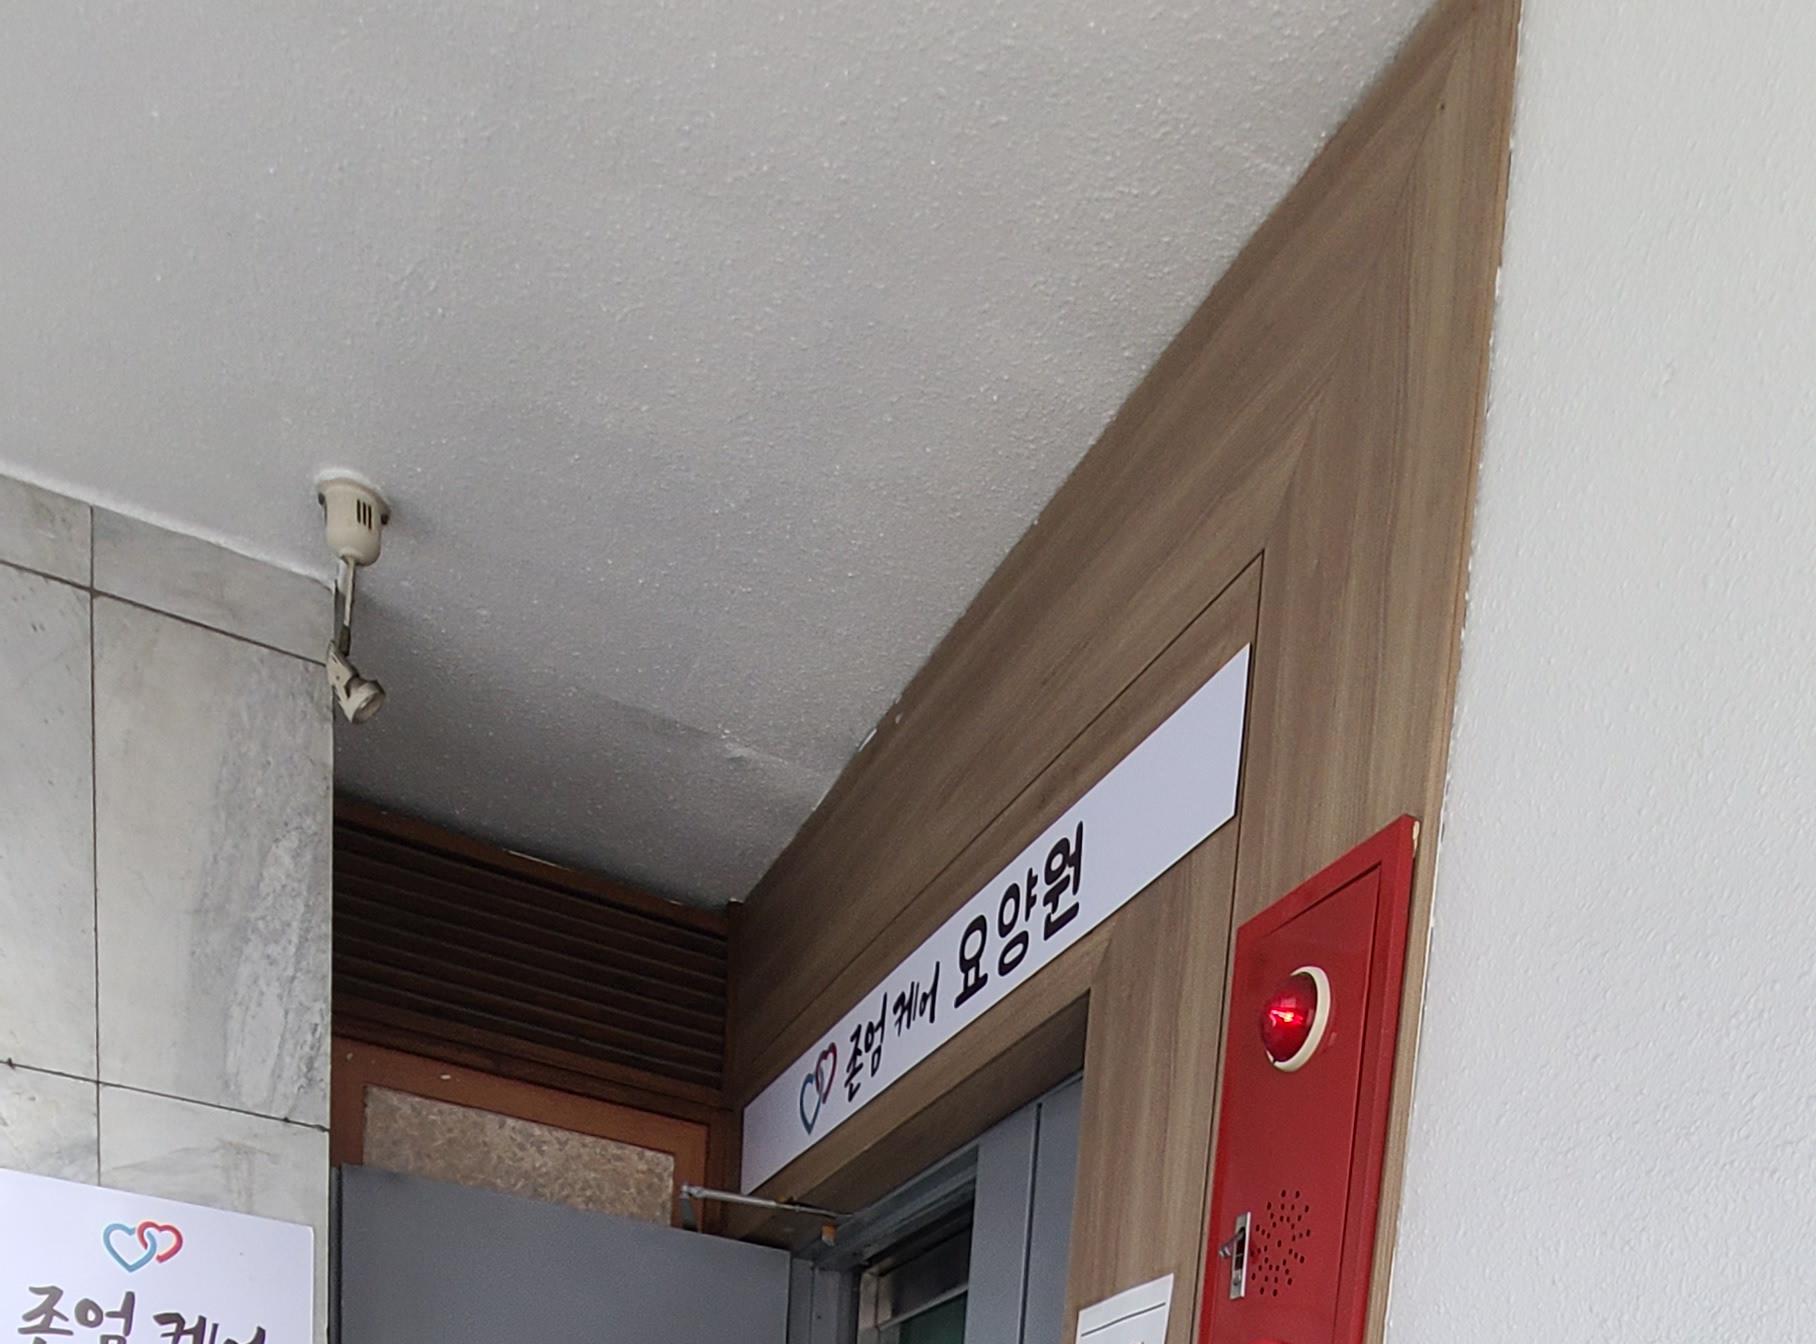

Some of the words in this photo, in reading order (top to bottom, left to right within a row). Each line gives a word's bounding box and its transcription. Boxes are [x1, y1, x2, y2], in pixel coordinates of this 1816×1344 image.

[844, 992, 888, 1102] 존엄
[892, 961, 941, 1037] 케어
[954, 821, 1083, 1008] 요양원
